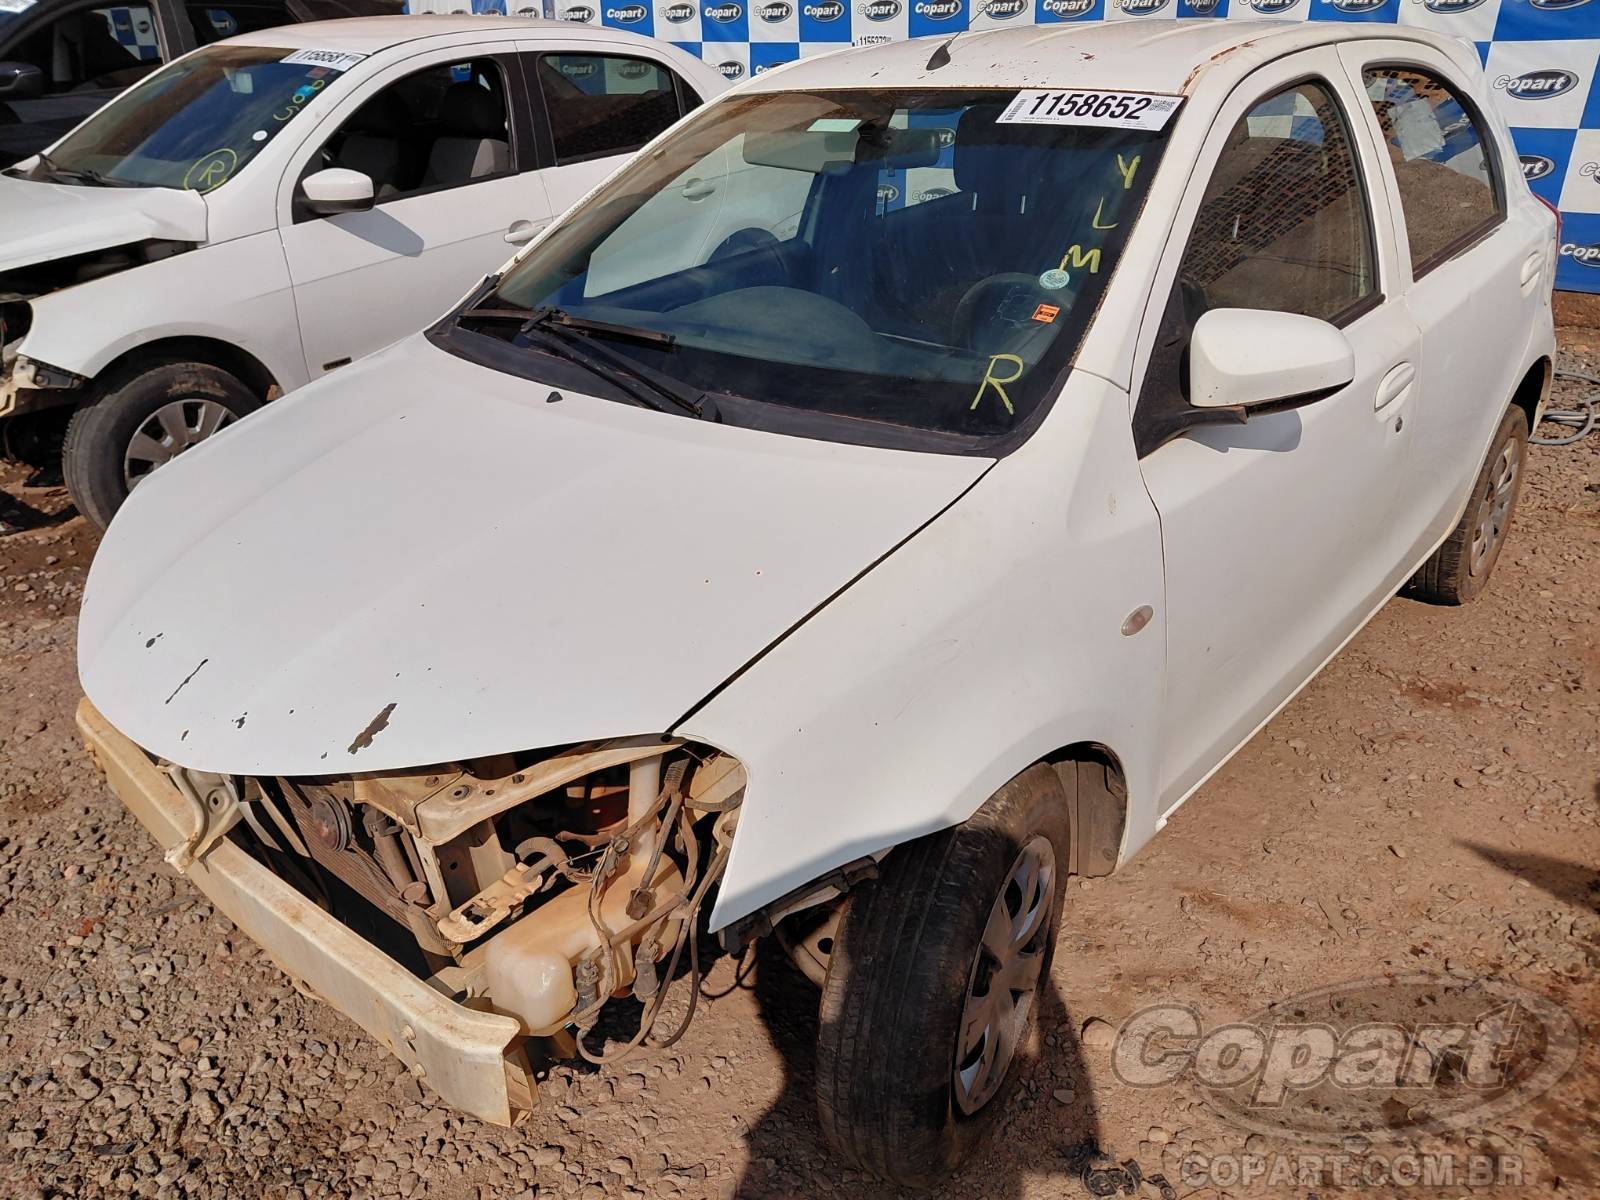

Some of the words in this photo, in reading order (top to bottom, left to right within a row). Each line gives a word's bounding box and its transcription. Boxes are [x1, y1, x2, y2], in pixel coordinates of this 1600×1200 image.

[704, 6, 738, 18] Copart
[754, 5, 788, 17] Copart
[804, 5, 840, 18] Copart
[858, 3, 896, 16] Copart
[915, 2, 956, 15] Copart
[977, 0, 1021, 13] Copart
[1043, 0, 1088, 12] Copart
[559, 9, 589, 21] Copart
[607, 8, 642, 20] Copart
[659, 7, 690, 20] Copart
[1493, 74, 1568, 93] Copart
[1029, 92, 1153, 120] 1158652
[969, 353, 1025, 416] R
